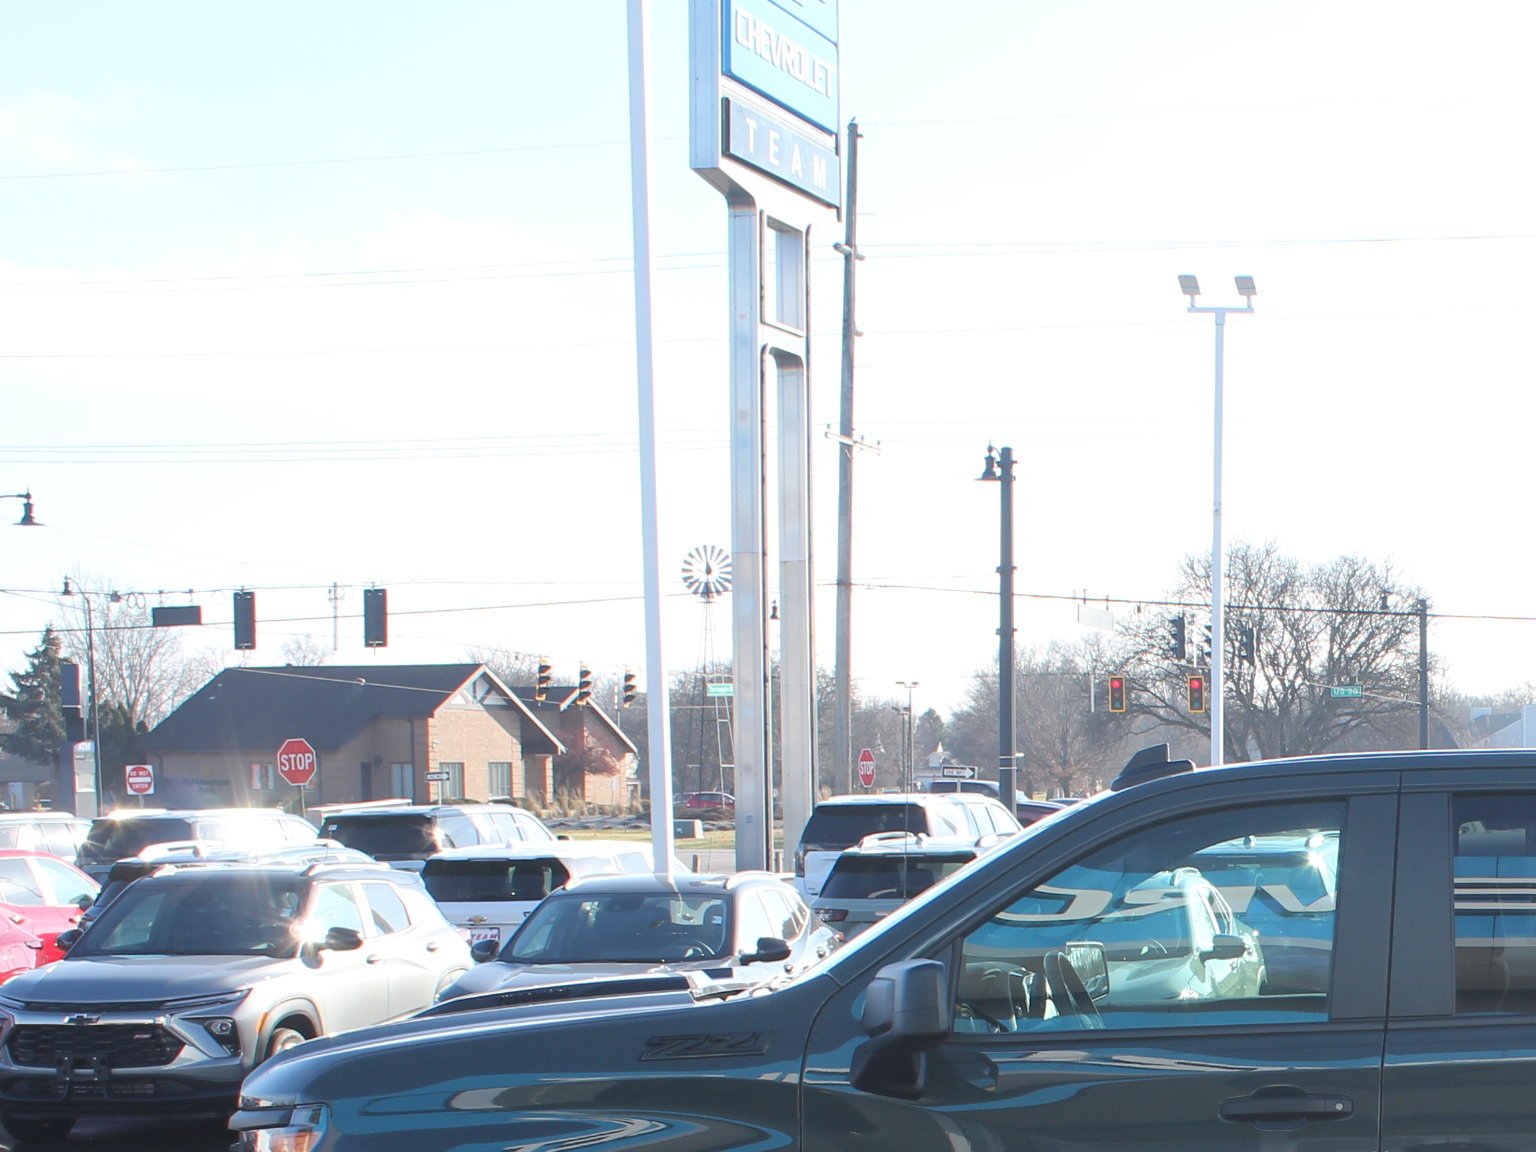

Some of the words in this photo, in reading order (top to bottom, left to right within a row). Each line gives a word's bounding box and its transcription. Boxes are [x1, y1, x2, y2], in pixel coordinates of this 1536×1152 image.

[735, 8, 835, 98] CHEVROLET
[744, 117, 828, 191] TEAM
[281, 753, 313, 771] STOP
[860, 761, 874, 775] STOP
